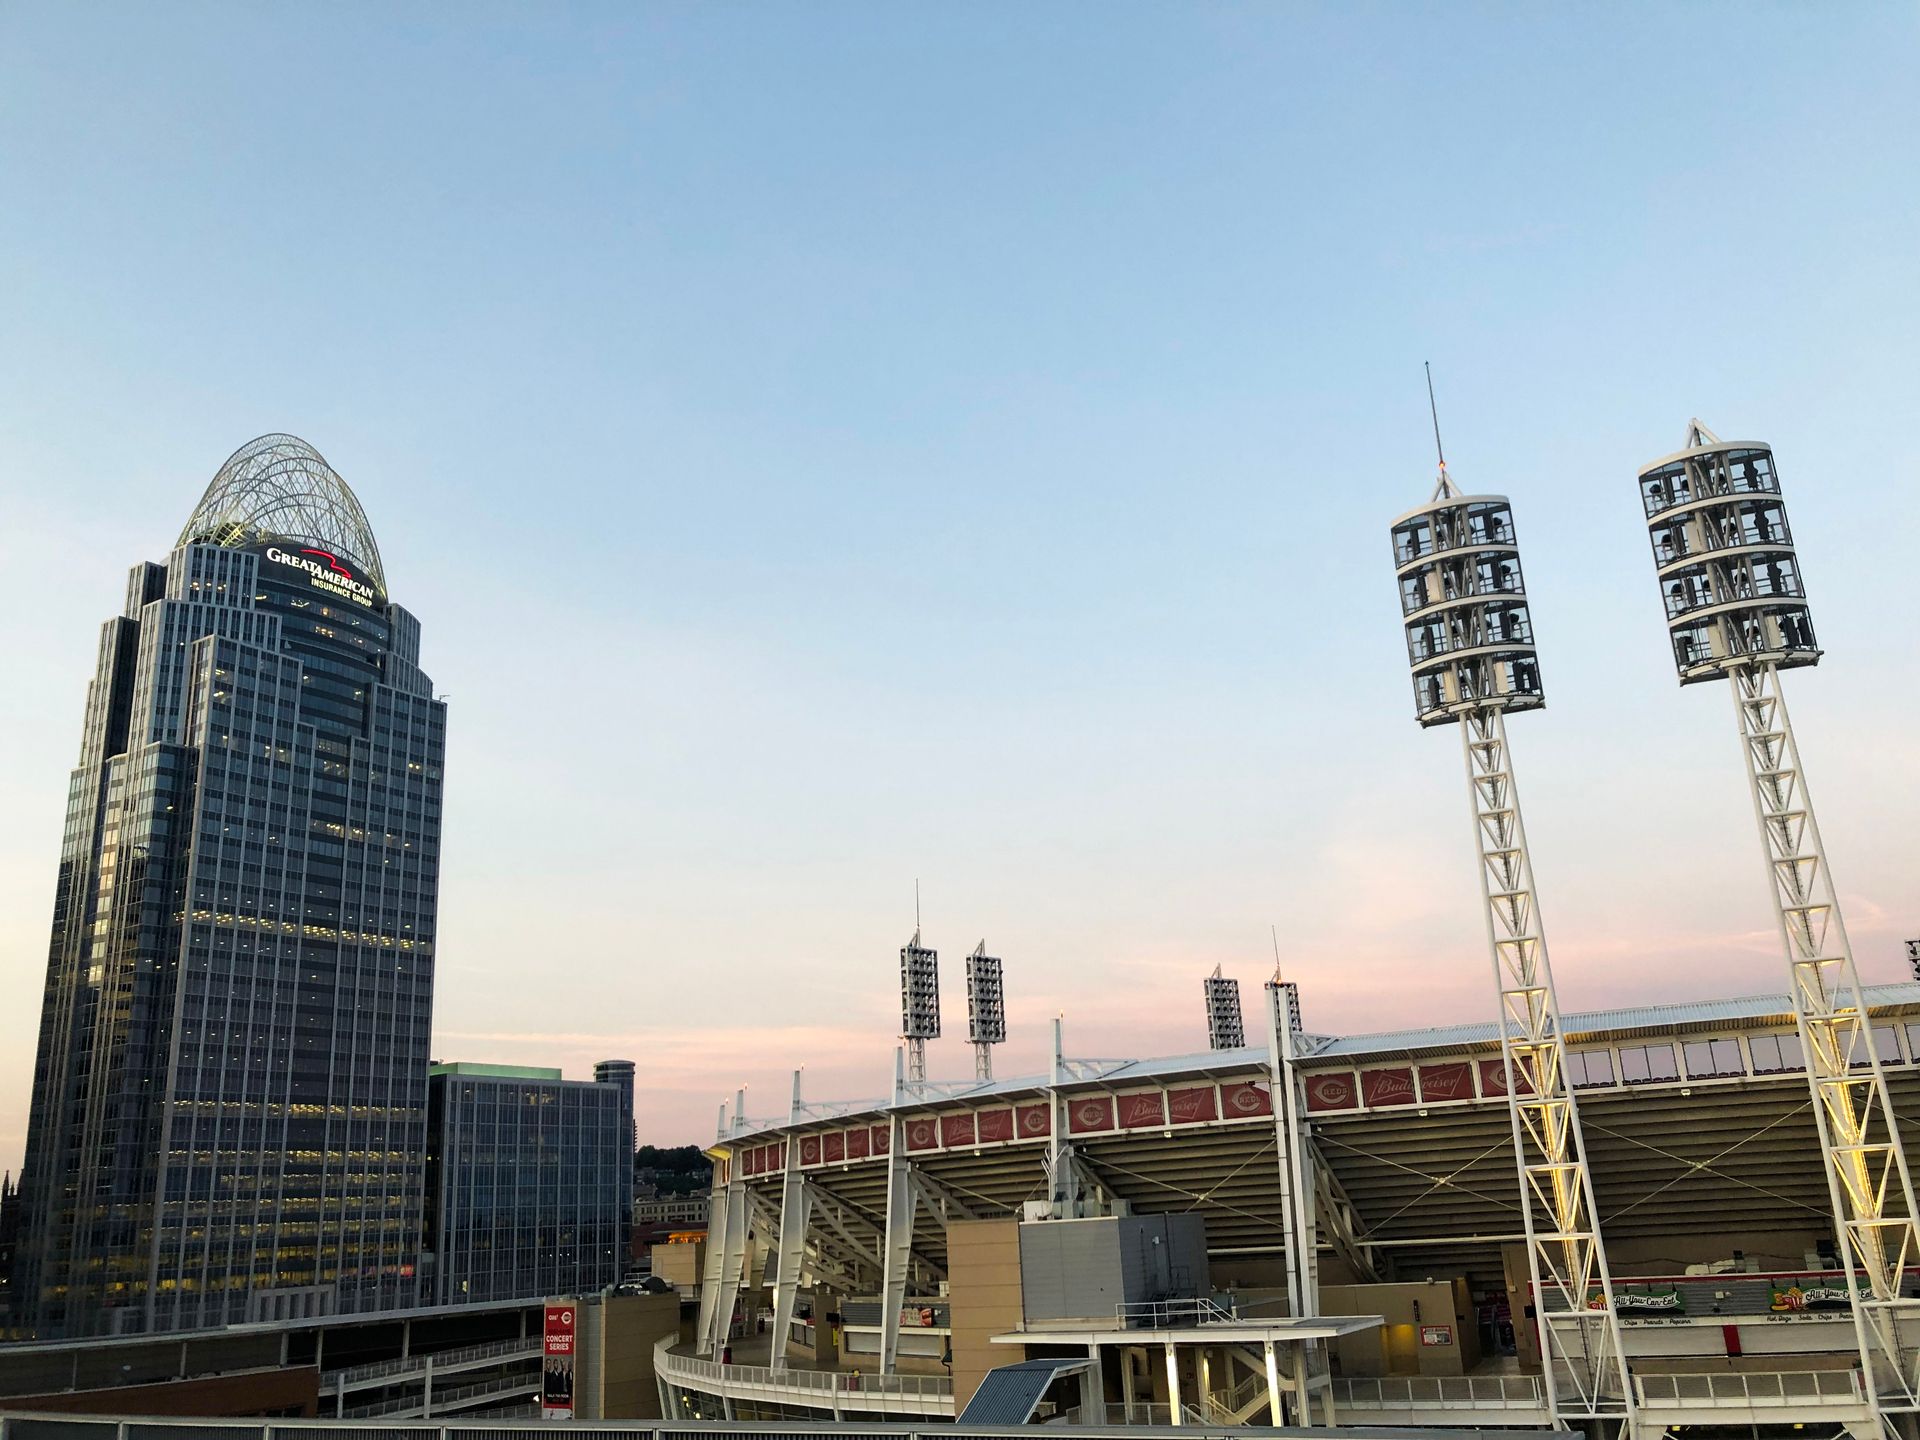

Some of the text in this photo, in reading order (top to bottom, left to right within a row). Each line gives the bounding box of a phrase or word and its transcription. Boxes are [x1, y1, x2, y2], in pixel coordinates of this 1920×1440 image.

[266, 547, 374, 599] GREAT AMERICAN
[311, 577, 373, 608] INSURANCE GROUP
[1323, 1087, 1347, 1096] REDS
[545, 1334, 573, 1343] CONCERT
[549, 1342, 569, 1351] SERIES
